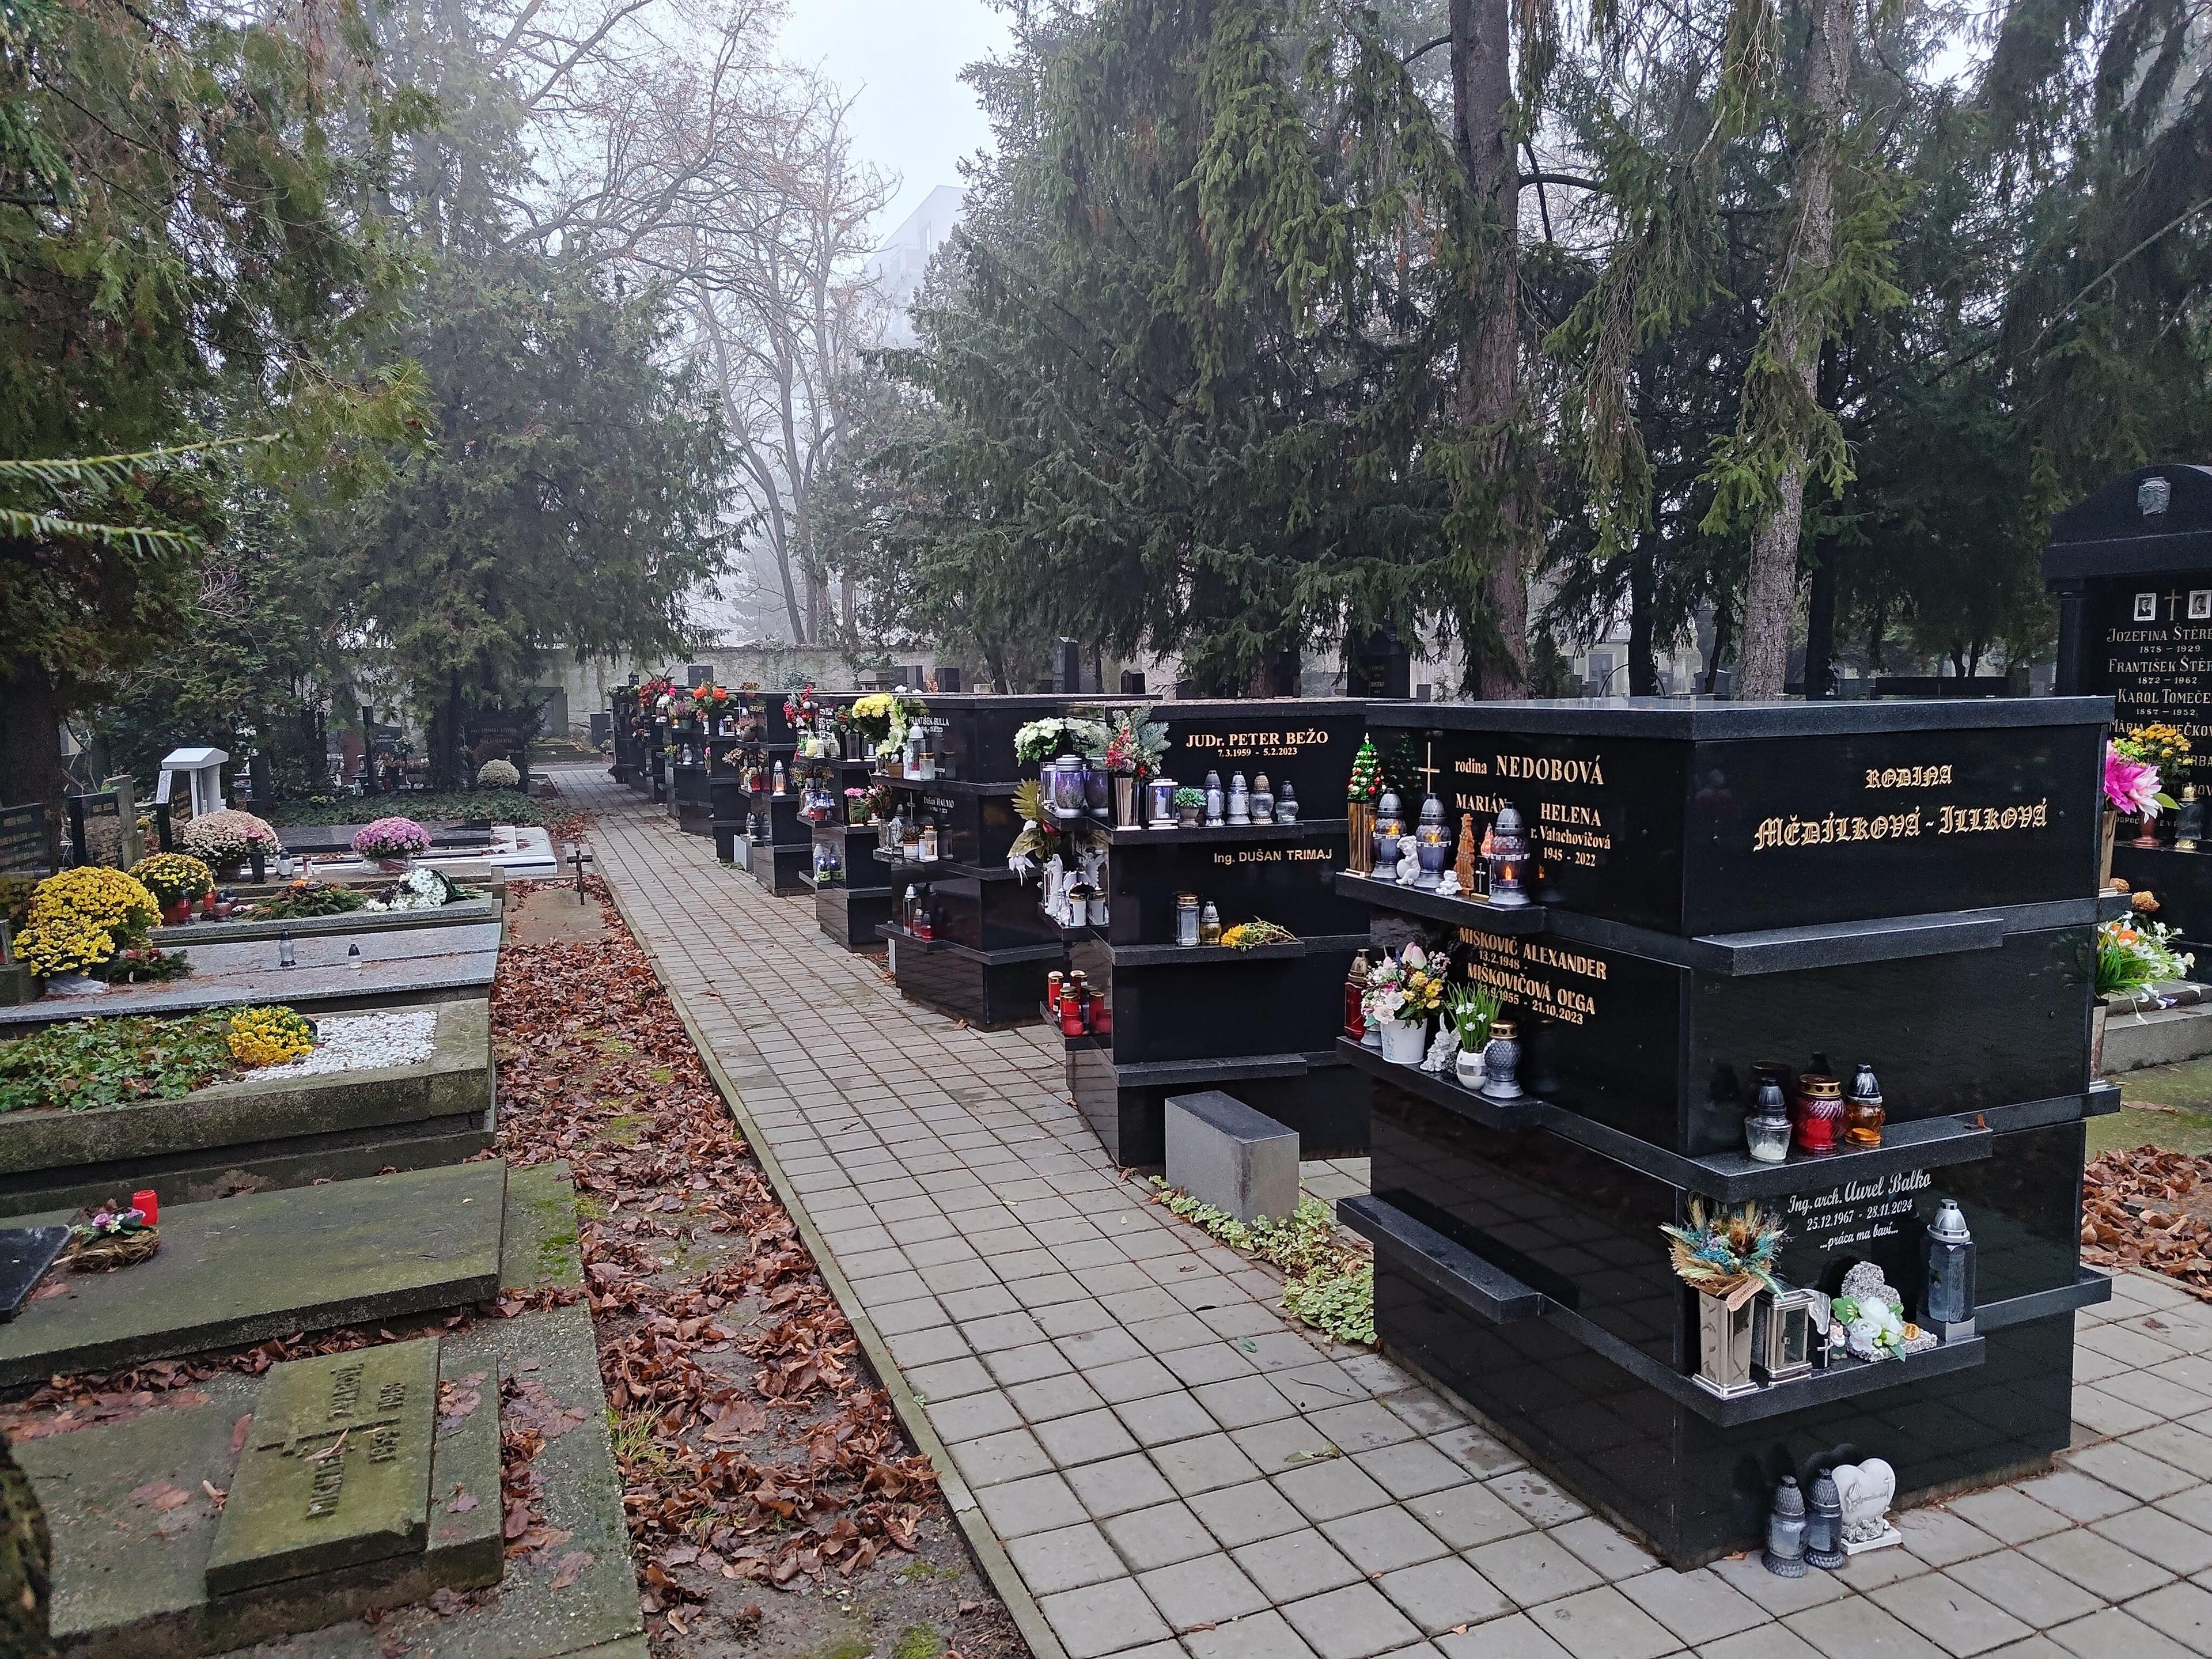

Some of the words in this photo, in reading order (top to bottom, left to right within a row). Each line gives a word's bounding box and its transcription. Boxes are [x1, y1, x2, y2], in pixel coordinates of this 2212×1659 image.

[2107, 628, 2168, 642] JOZEFINA
[2108, 658, 2176, 672] FRANTIŠEK
[2118, 688, 2159, 703] KAROL
[2162, 689, 2212, 703] TOMEČE
[1186, 734, 1225, 747] JUDr.
[1229, 733, 1280, 746] PETER
[1285, 728, 1328, 744] BEŽO
[1263, 747, 1297, 756] 5.2.2023
[1455, 758, 1487, 774] rodina
[1496, 755, 1604, 785] NEDOBOVÁ
[1865, 764, 1952, 789] RODINA
[1540, 802, 1601, 826] HELENA
[1531, 827, 1537, 839] r.
[1540, 825, 1611, 850] Valachovičová
[1214, 853, 1235, 865] Ing.
[1239, 849, 1281, 862] DUŠAN
[1286, 849, 1332, 861] TRIMAJ
[1543, 847, 1563, 861] 1945
[1575, 852, 1596, 867] 2022
[1479, 950, 1520, 970] 13.2.1948
[1523, 943, 1607, 980] ALEXANDER
[1468, 963, 1551, 1001] MIŠKOVIČOVÁ
[1557, 988, 1595, 1015] OĽGA
[1532, 999, 1584, 1025] 21.10.2023
[1787, 1195, 1813, 1216] Ing.
[1814, 1187, 1842, 1207] arch.
[1844, 1176, 1884, 1202] Aurel
[1888, 1169, 1931, 1194] Balko
[1806, 1210, 1854, 1232] 25.12.1967
[1866, 1199, 1912, 1219] 28.11.2024
[1857, 1230, 1870, 1241] ma
